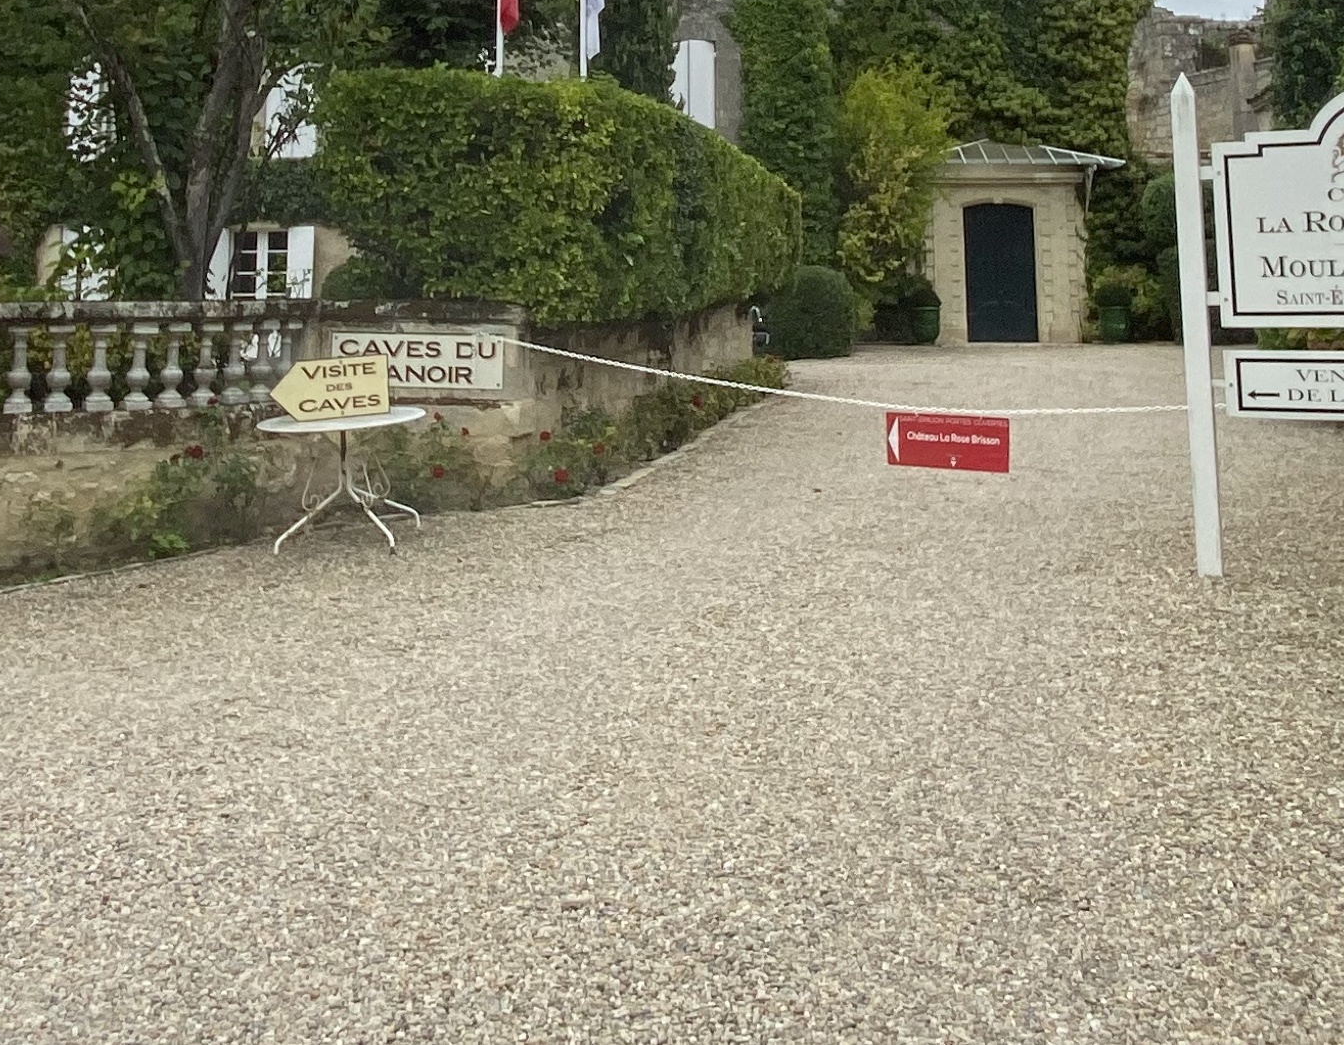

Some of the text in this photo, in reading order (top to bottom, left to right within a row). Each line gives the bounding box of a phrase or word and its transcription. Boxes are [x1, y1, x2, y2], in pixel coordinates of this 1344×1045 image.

[1257, 217, 1294, 234] LA
[339, 339, 497, 360] CAVES DU
[301, 362, 377, 380] VISITE
[388, 365, 474, 385] ANOIR
[325, 382, 353, 393] DES
[1287, 388, 1322, 402] DE
[298, 394, 381, 414] CAVES
[940, 432, 950, 442] La
[951, 433, 970, 444] Rose
[971, 434, 1000, 445] Brisson
